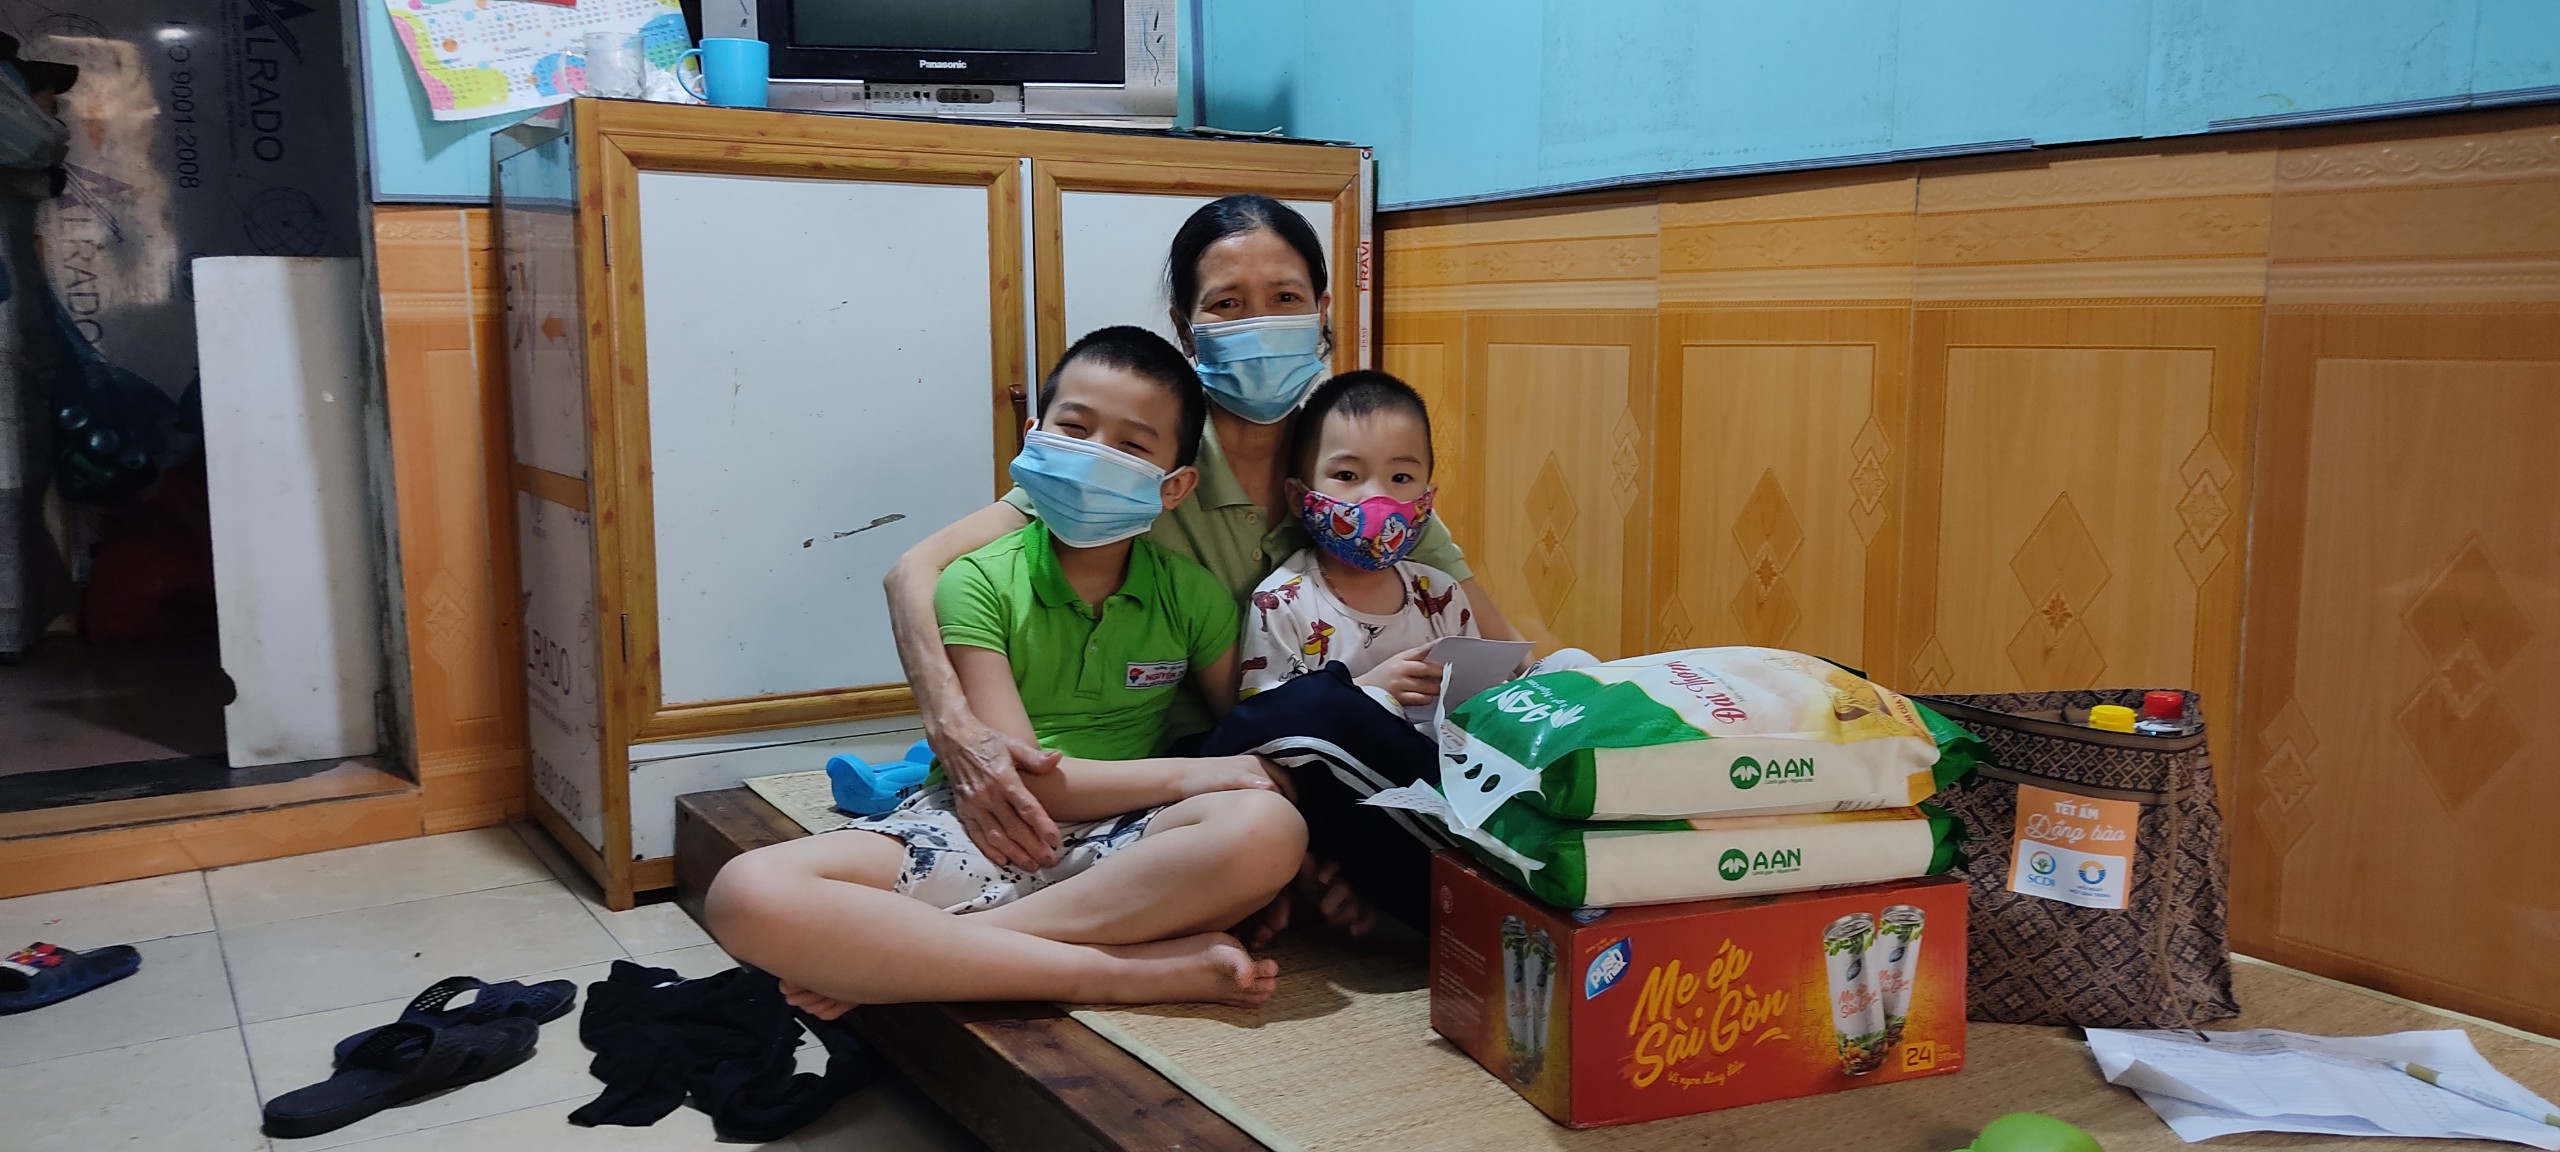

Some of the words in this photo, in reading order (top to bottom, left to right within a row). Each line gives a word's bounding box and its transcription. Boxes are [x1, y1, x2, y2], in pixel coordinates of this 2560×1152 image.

[167, 20, 190, 63] IO
[919, 60, 967, 69] Panasonic
[169, 71, 202, 189] 9001:2008
[1361, 240, 1370, 292] FRAVI
[1766, 758, 1815, 778] AAN
[1752, 849, 1801, 870] AAN
[1629, 959, 1700, 1036] Me
[1707, 938, 1753, 998] ép
[1633, 1007, 1705, 1088] Sài
[1710, 983, 1790, 1053] Gòn
[1906, 1046, 1932, 1066] 24
